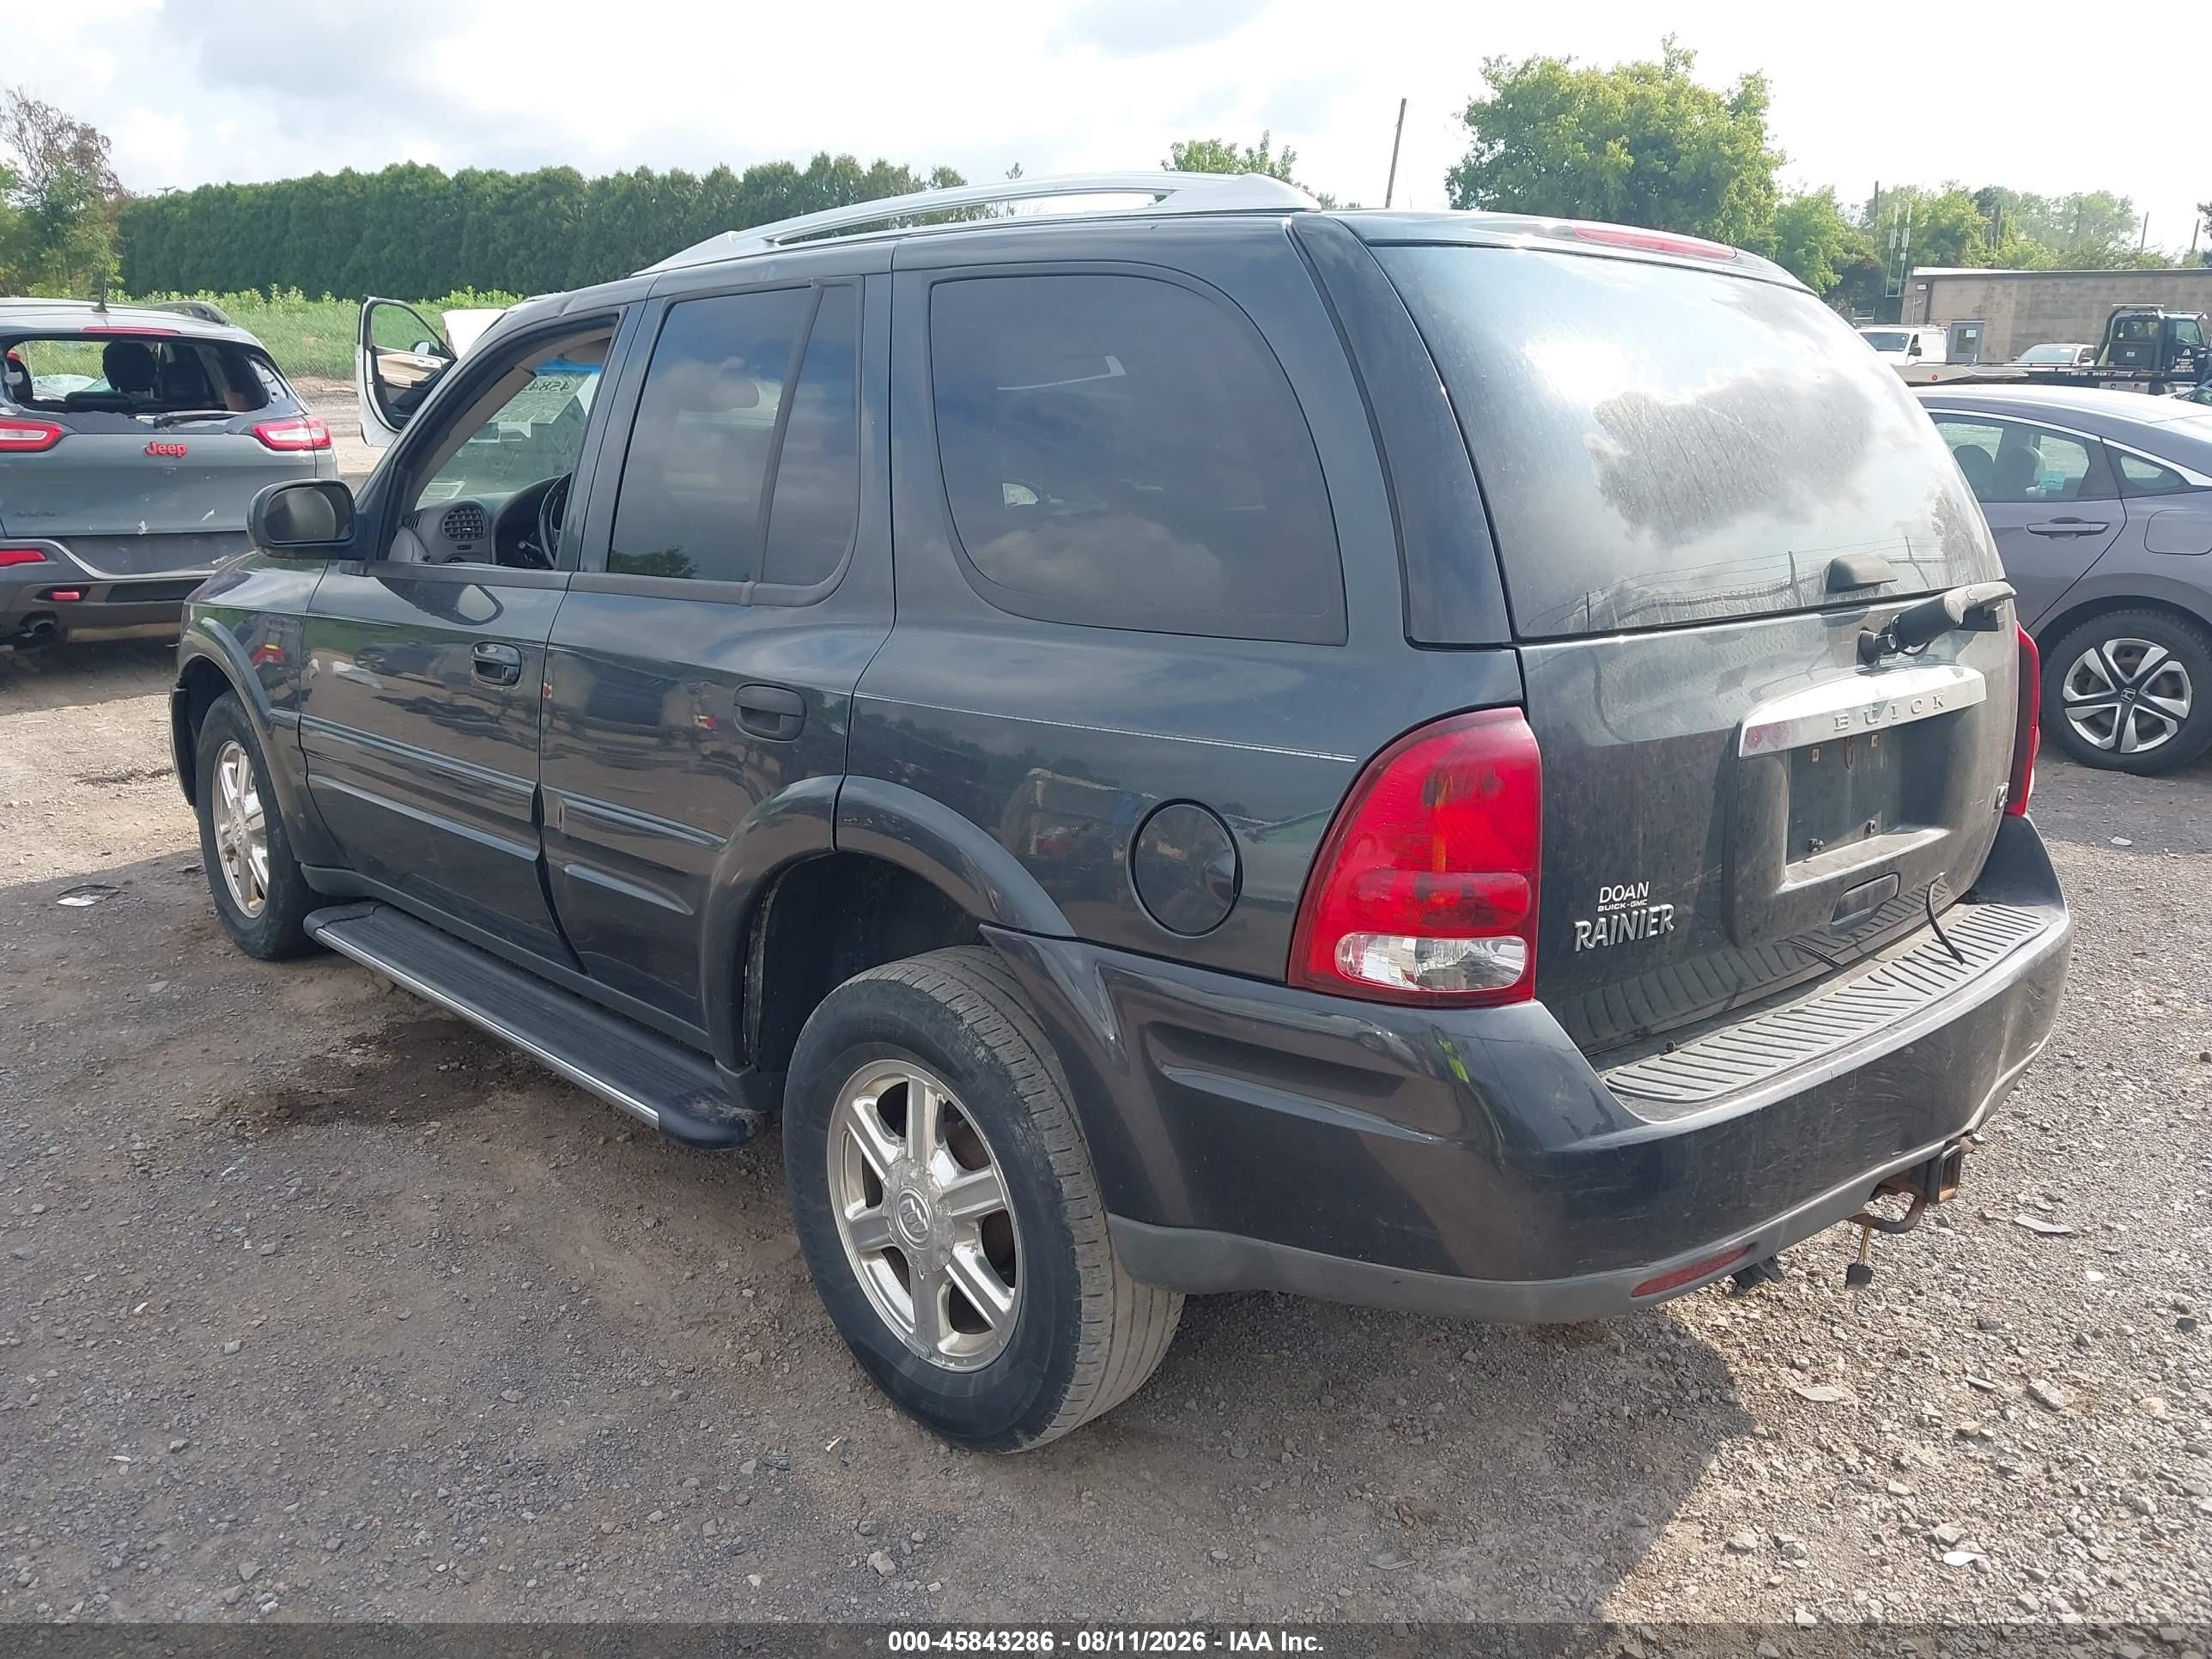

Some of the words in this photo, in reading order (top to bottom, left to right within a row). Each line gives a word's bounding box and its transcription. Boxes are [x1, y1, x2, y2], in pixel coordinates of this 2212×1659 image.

[144, 441, 187, 459] Jeep
[1832, 691, 1946, 732] BUICK
[1599, 880, 1650, 903] DOAN
[1597, 898, 1648, 912] BUICK-GMC
[1573, 903, 1674, 952] RAINIER
